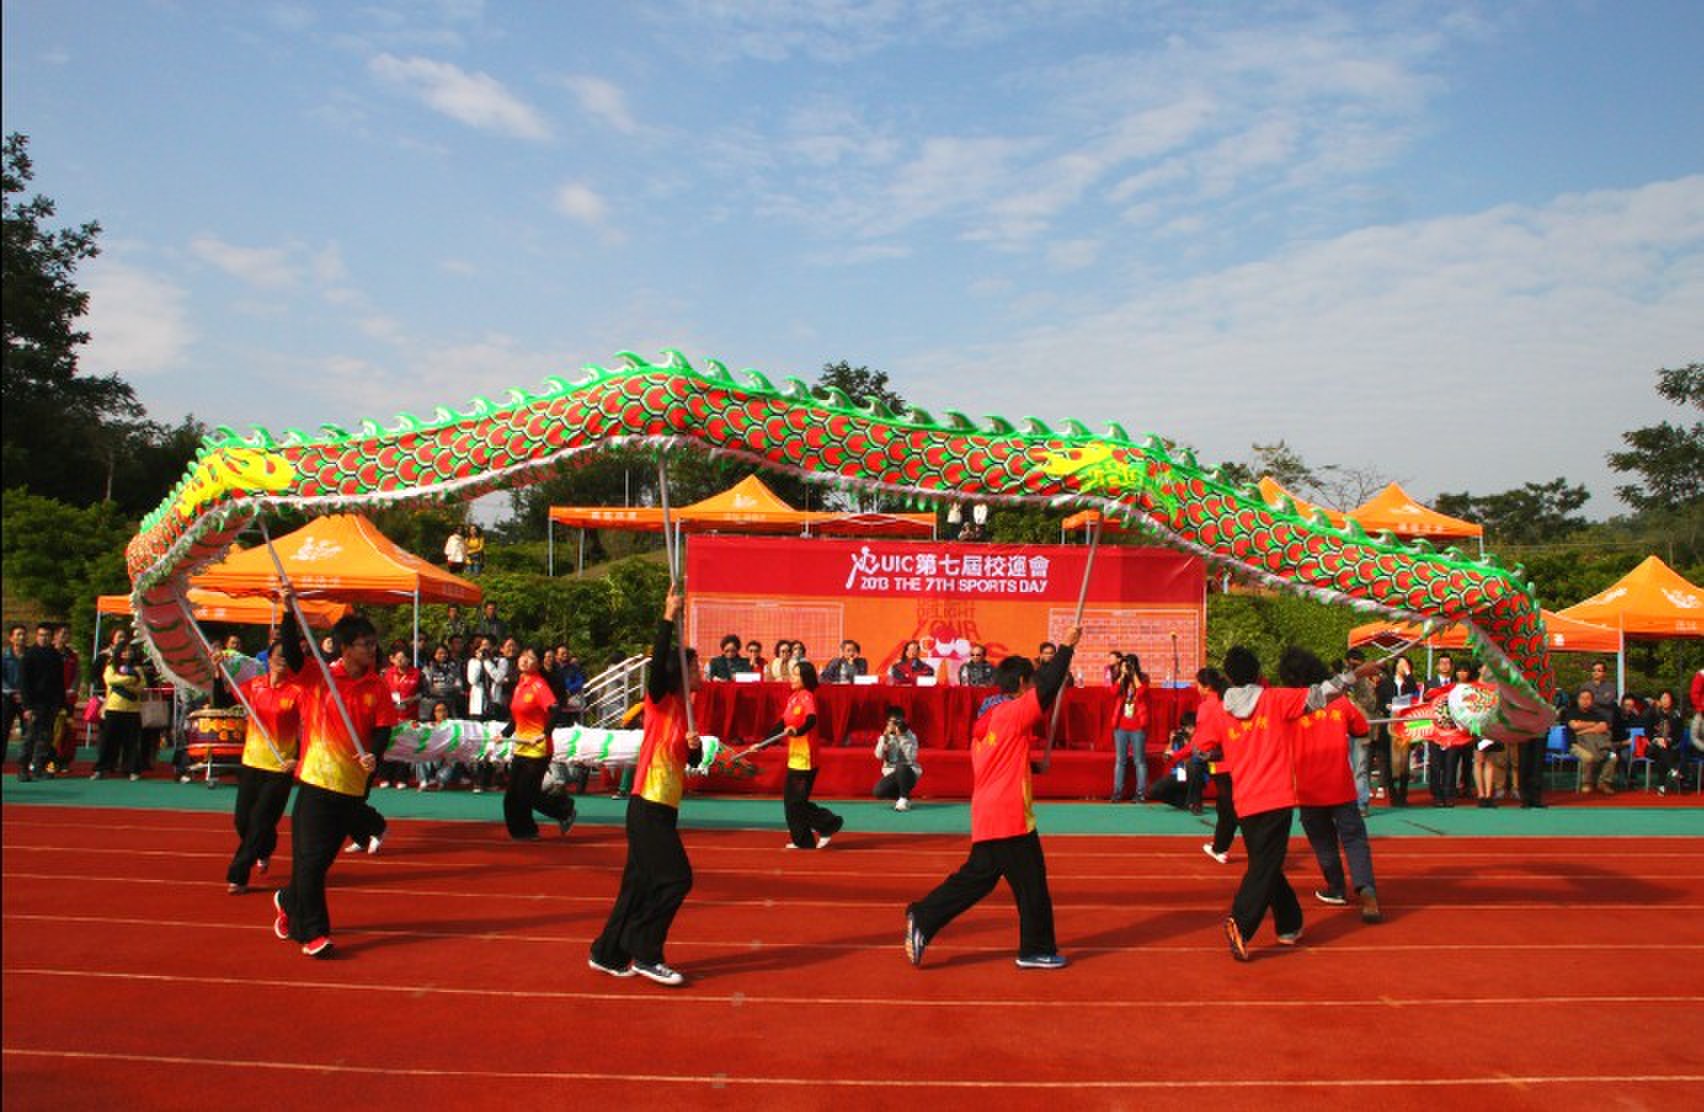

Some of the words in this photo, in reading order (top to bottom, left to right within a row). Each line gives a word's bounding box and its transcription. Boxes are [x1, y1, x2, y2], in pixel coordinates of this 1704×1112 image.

[894, 577, 921, 591] THE
[925, 578, 955, 592] 7TH
[959, 579, 1017, 592] SPORTS
[1019, 579, 1048, 592] DAY
